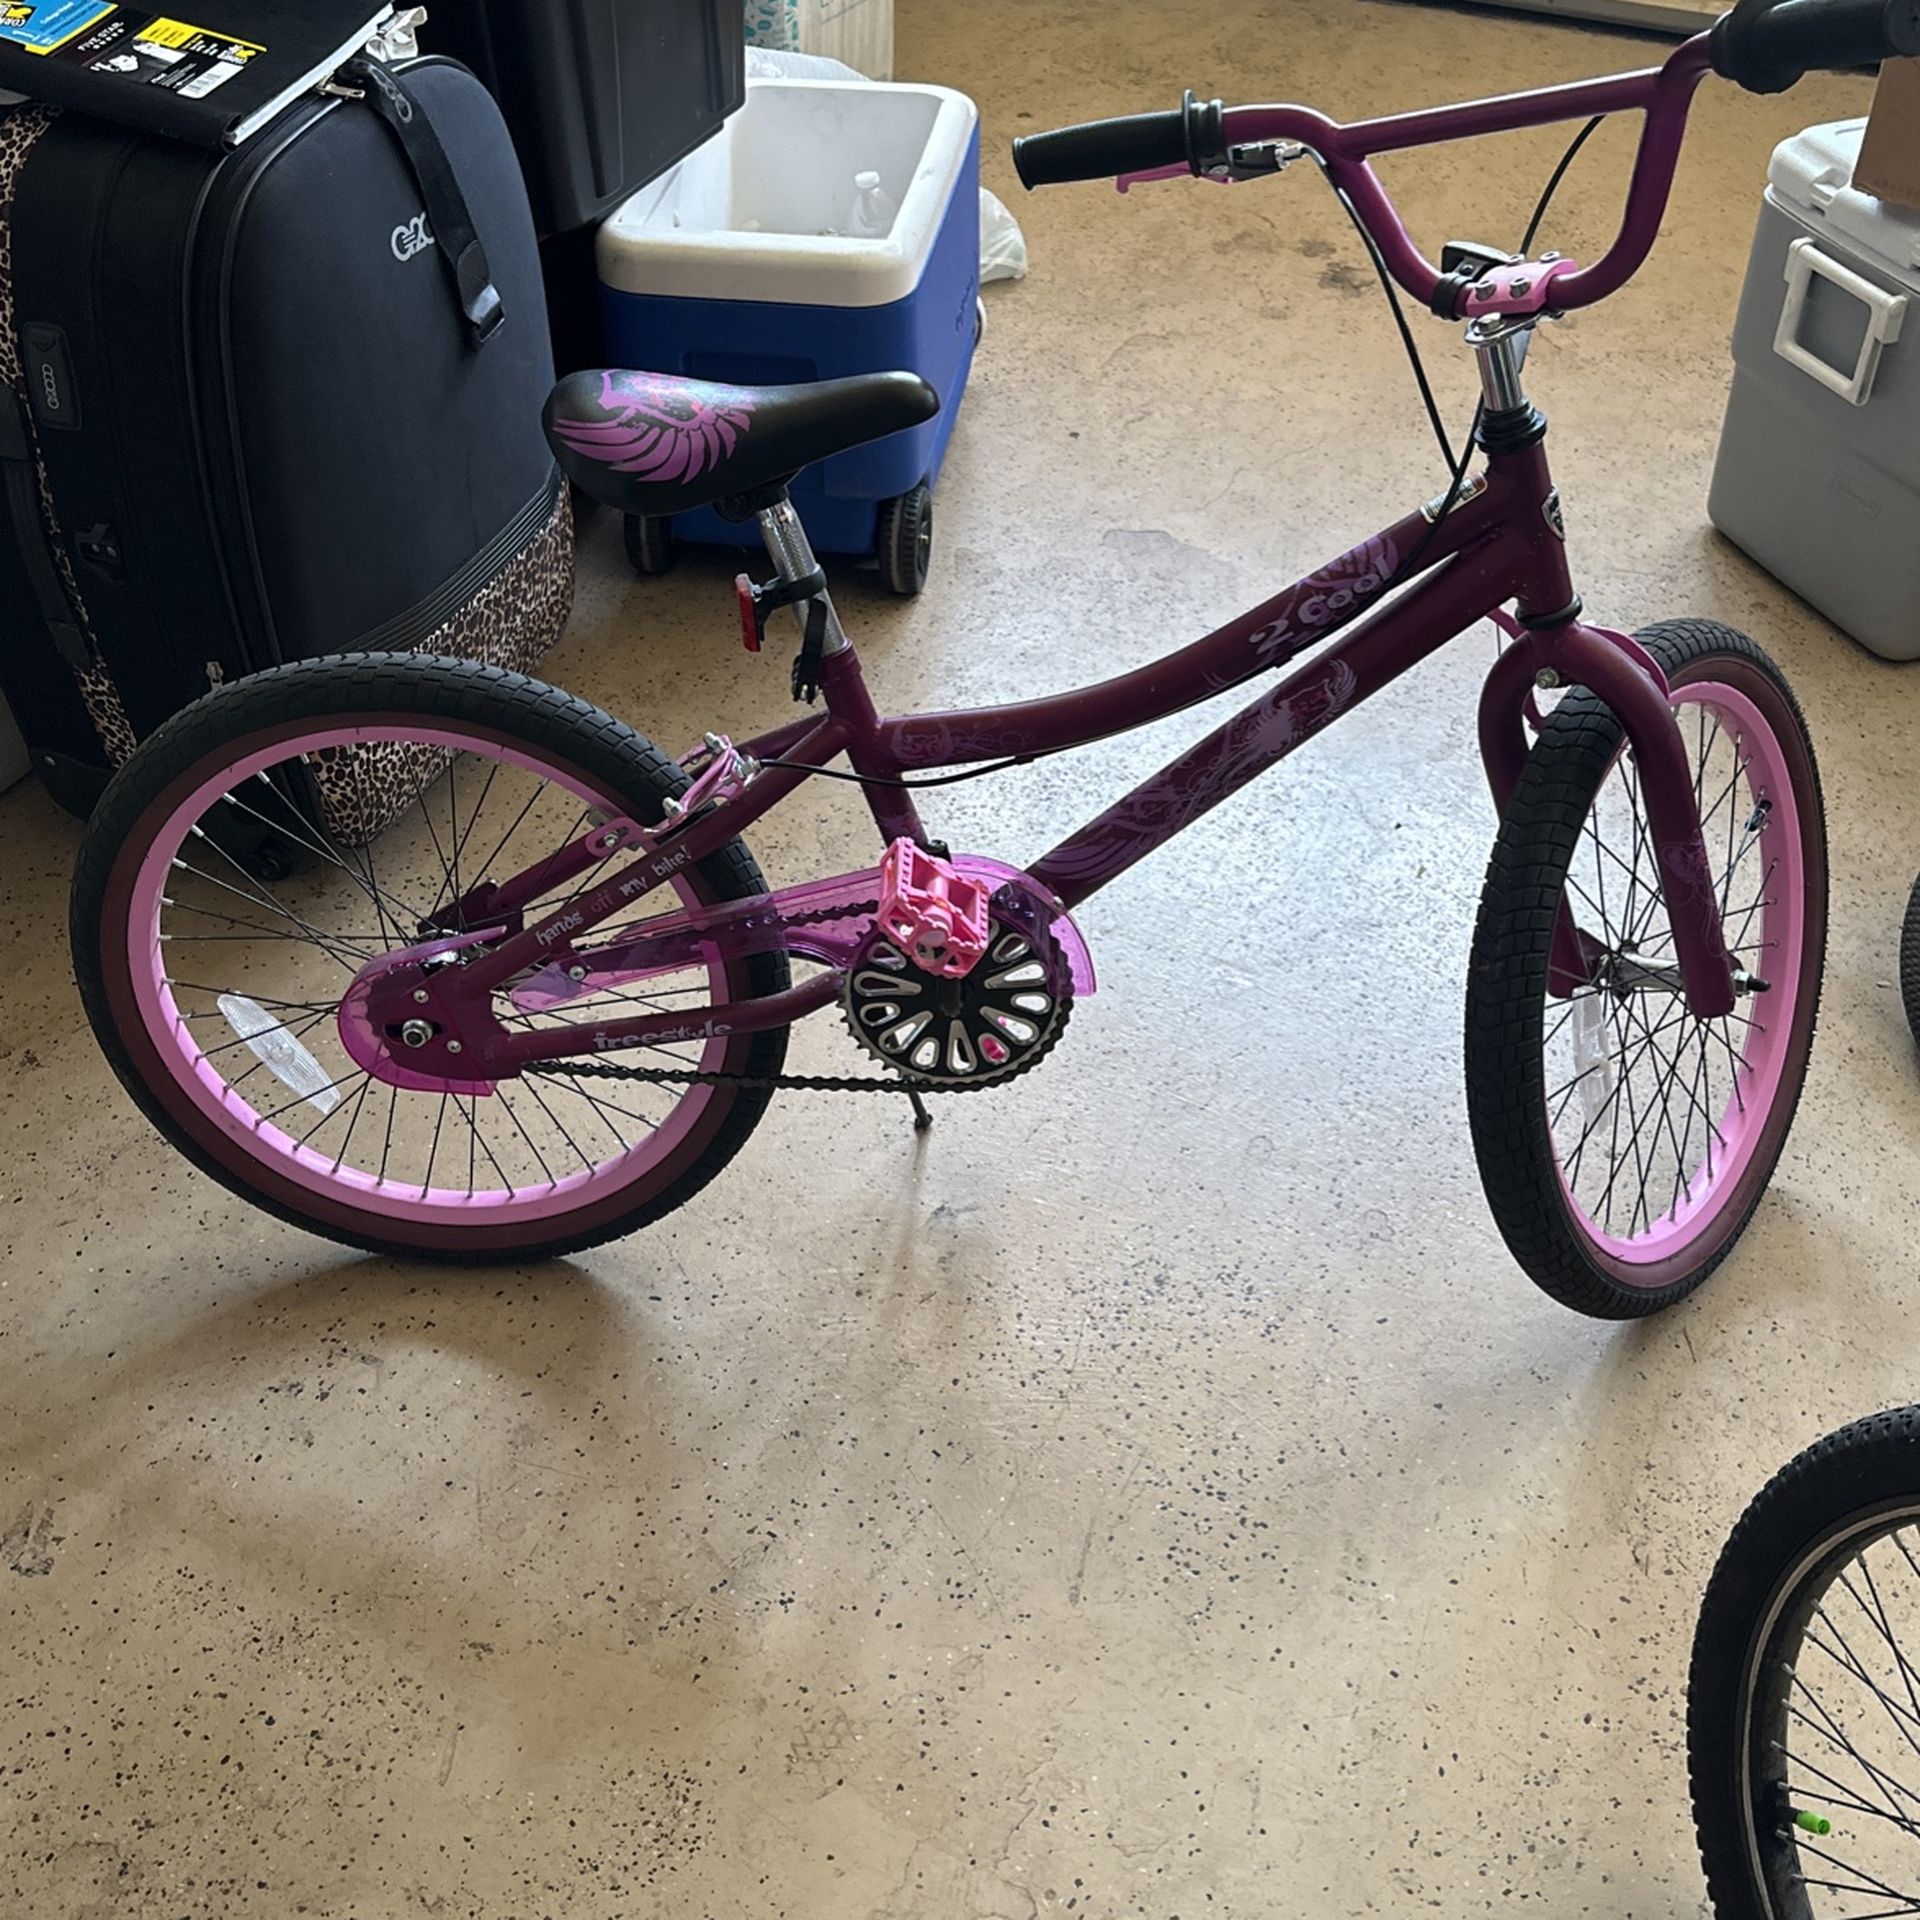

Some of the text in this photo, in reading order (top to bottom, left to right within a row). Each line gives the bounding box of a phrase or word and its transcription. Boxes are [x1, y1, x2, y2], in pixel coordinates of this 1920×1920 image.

[535, 845, 693, 947] hands off my bike!
[592, 1020, 733, 1050] freestyle
